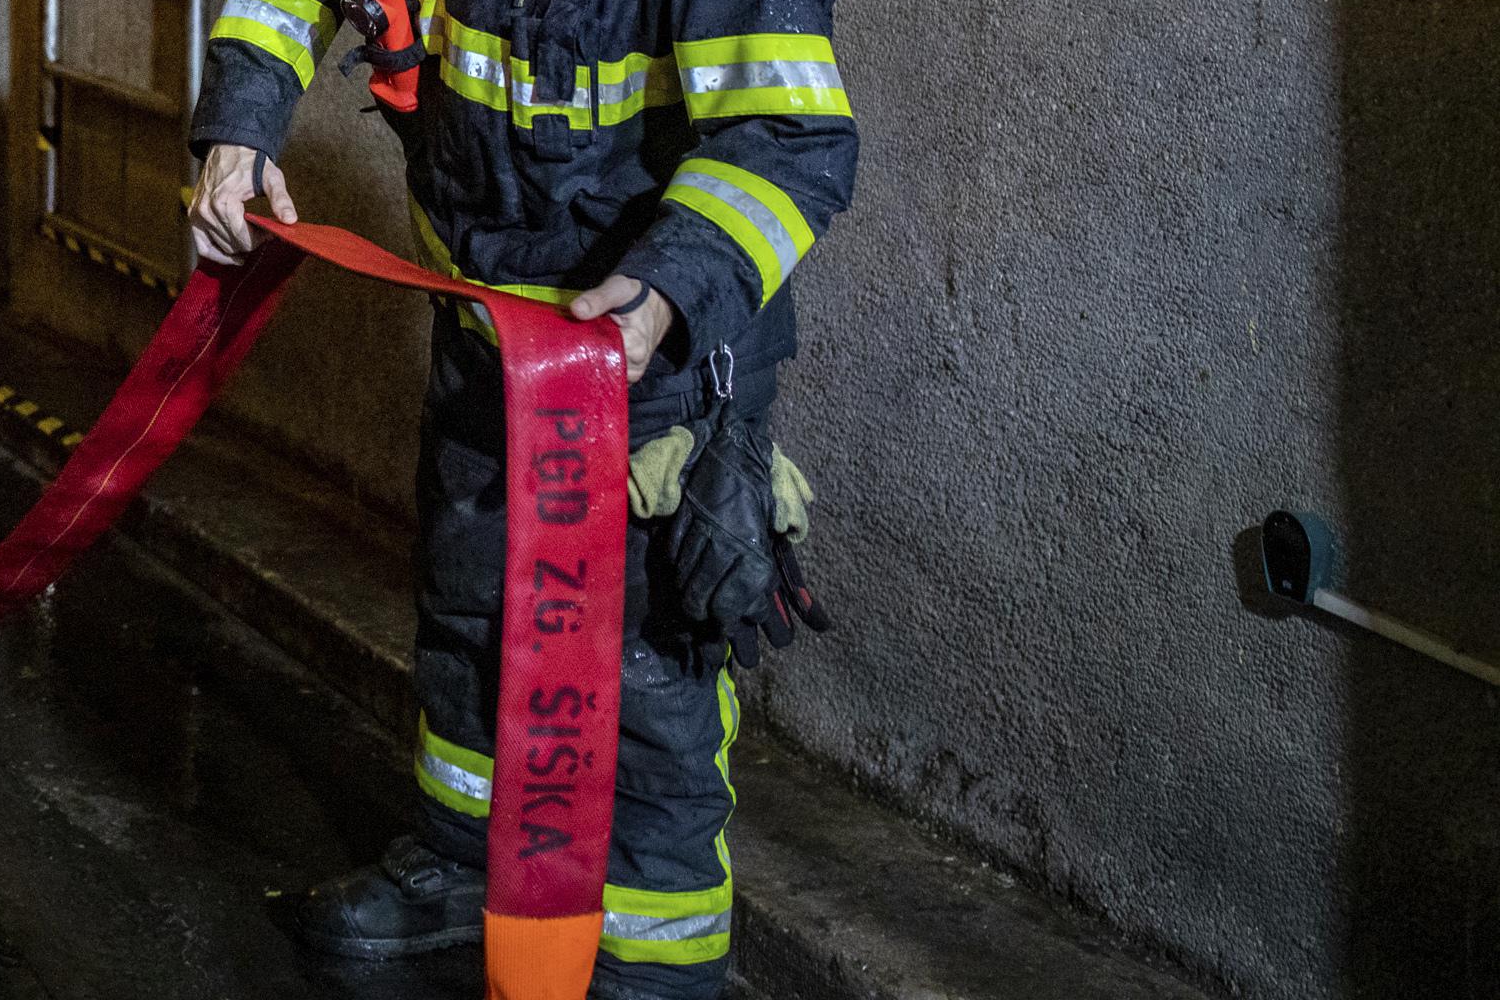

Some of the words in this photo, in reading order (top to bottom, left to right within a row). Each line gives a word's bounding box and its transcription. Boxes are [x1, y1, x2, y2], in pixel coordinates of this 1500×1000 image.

[533, 407, 589, 526] PGD
[532, 558, 587, 653] ZG.
[518, 684, 597, 861] ŠIŠKA
